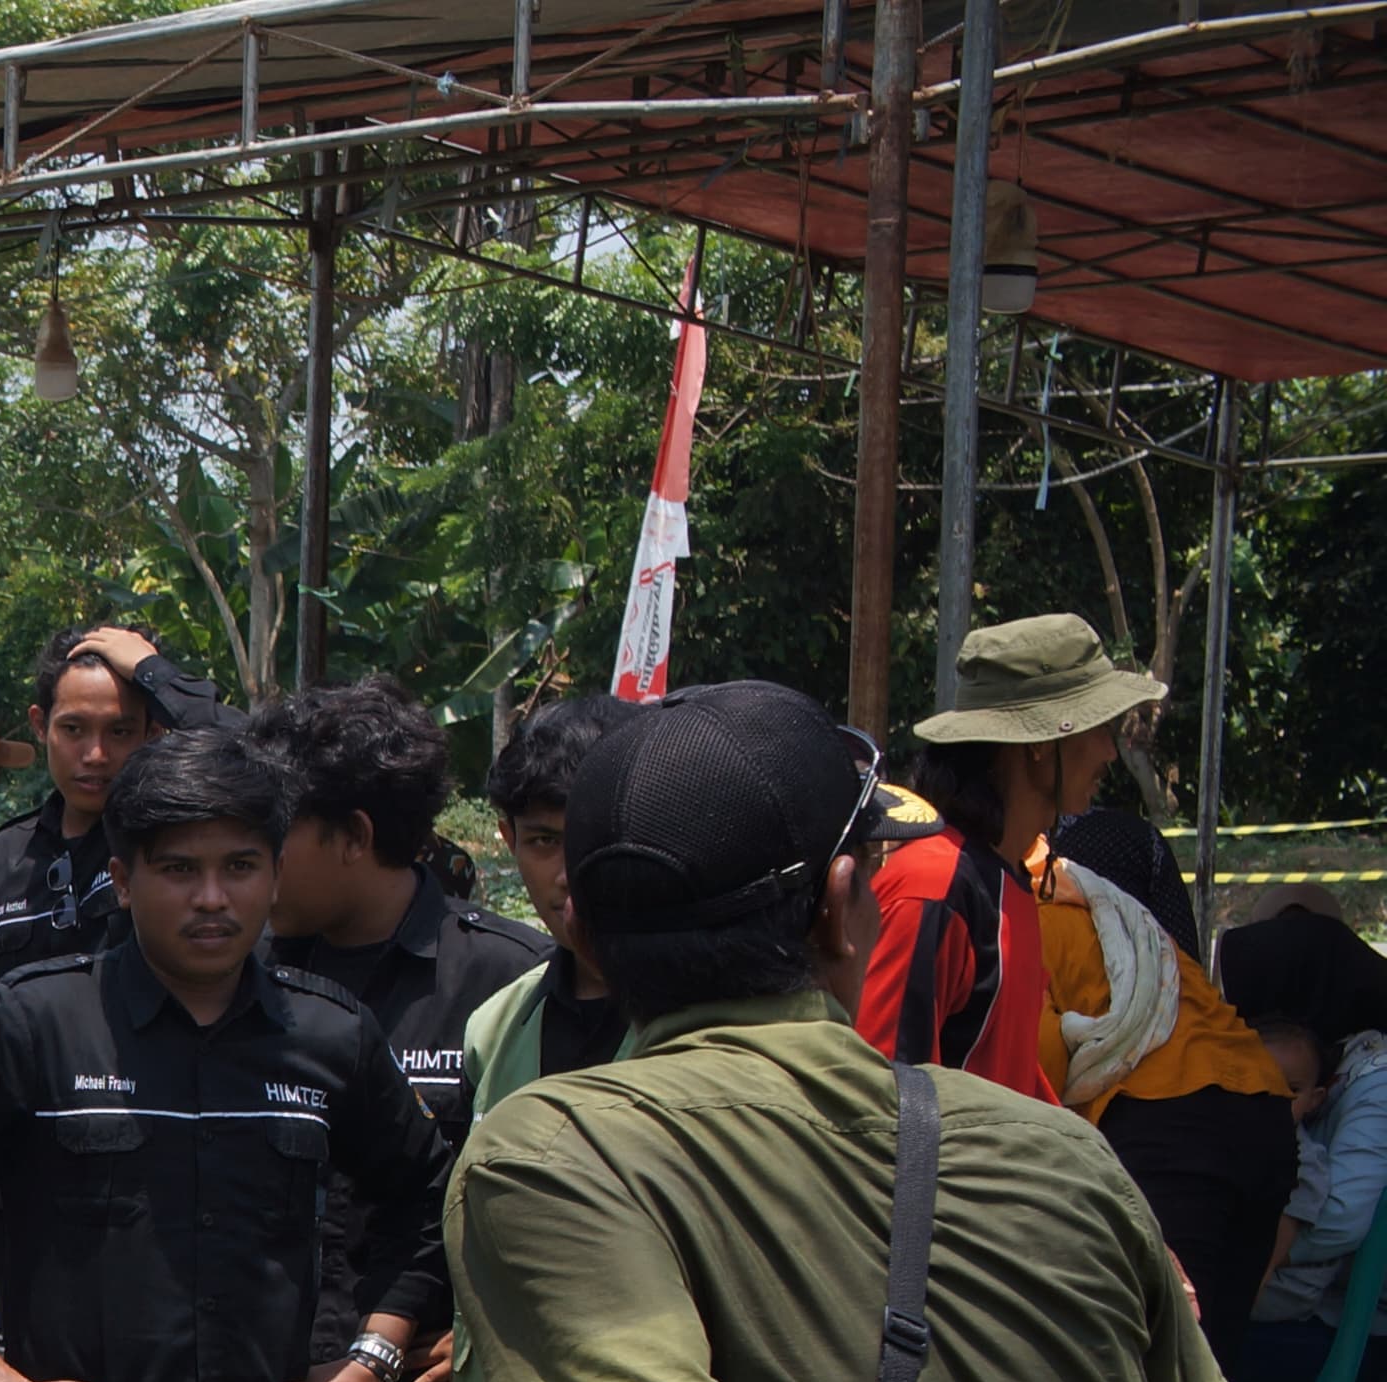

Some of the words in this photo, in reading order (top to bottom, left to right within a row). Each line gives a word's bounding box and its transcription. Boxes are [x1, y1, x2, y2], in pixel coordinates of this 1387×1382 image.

[75, 1074, 106, 1090] Michael
[108, 1075, 136, 1095] Franky
[265, 1082, 328, 1109] HIMTEL
